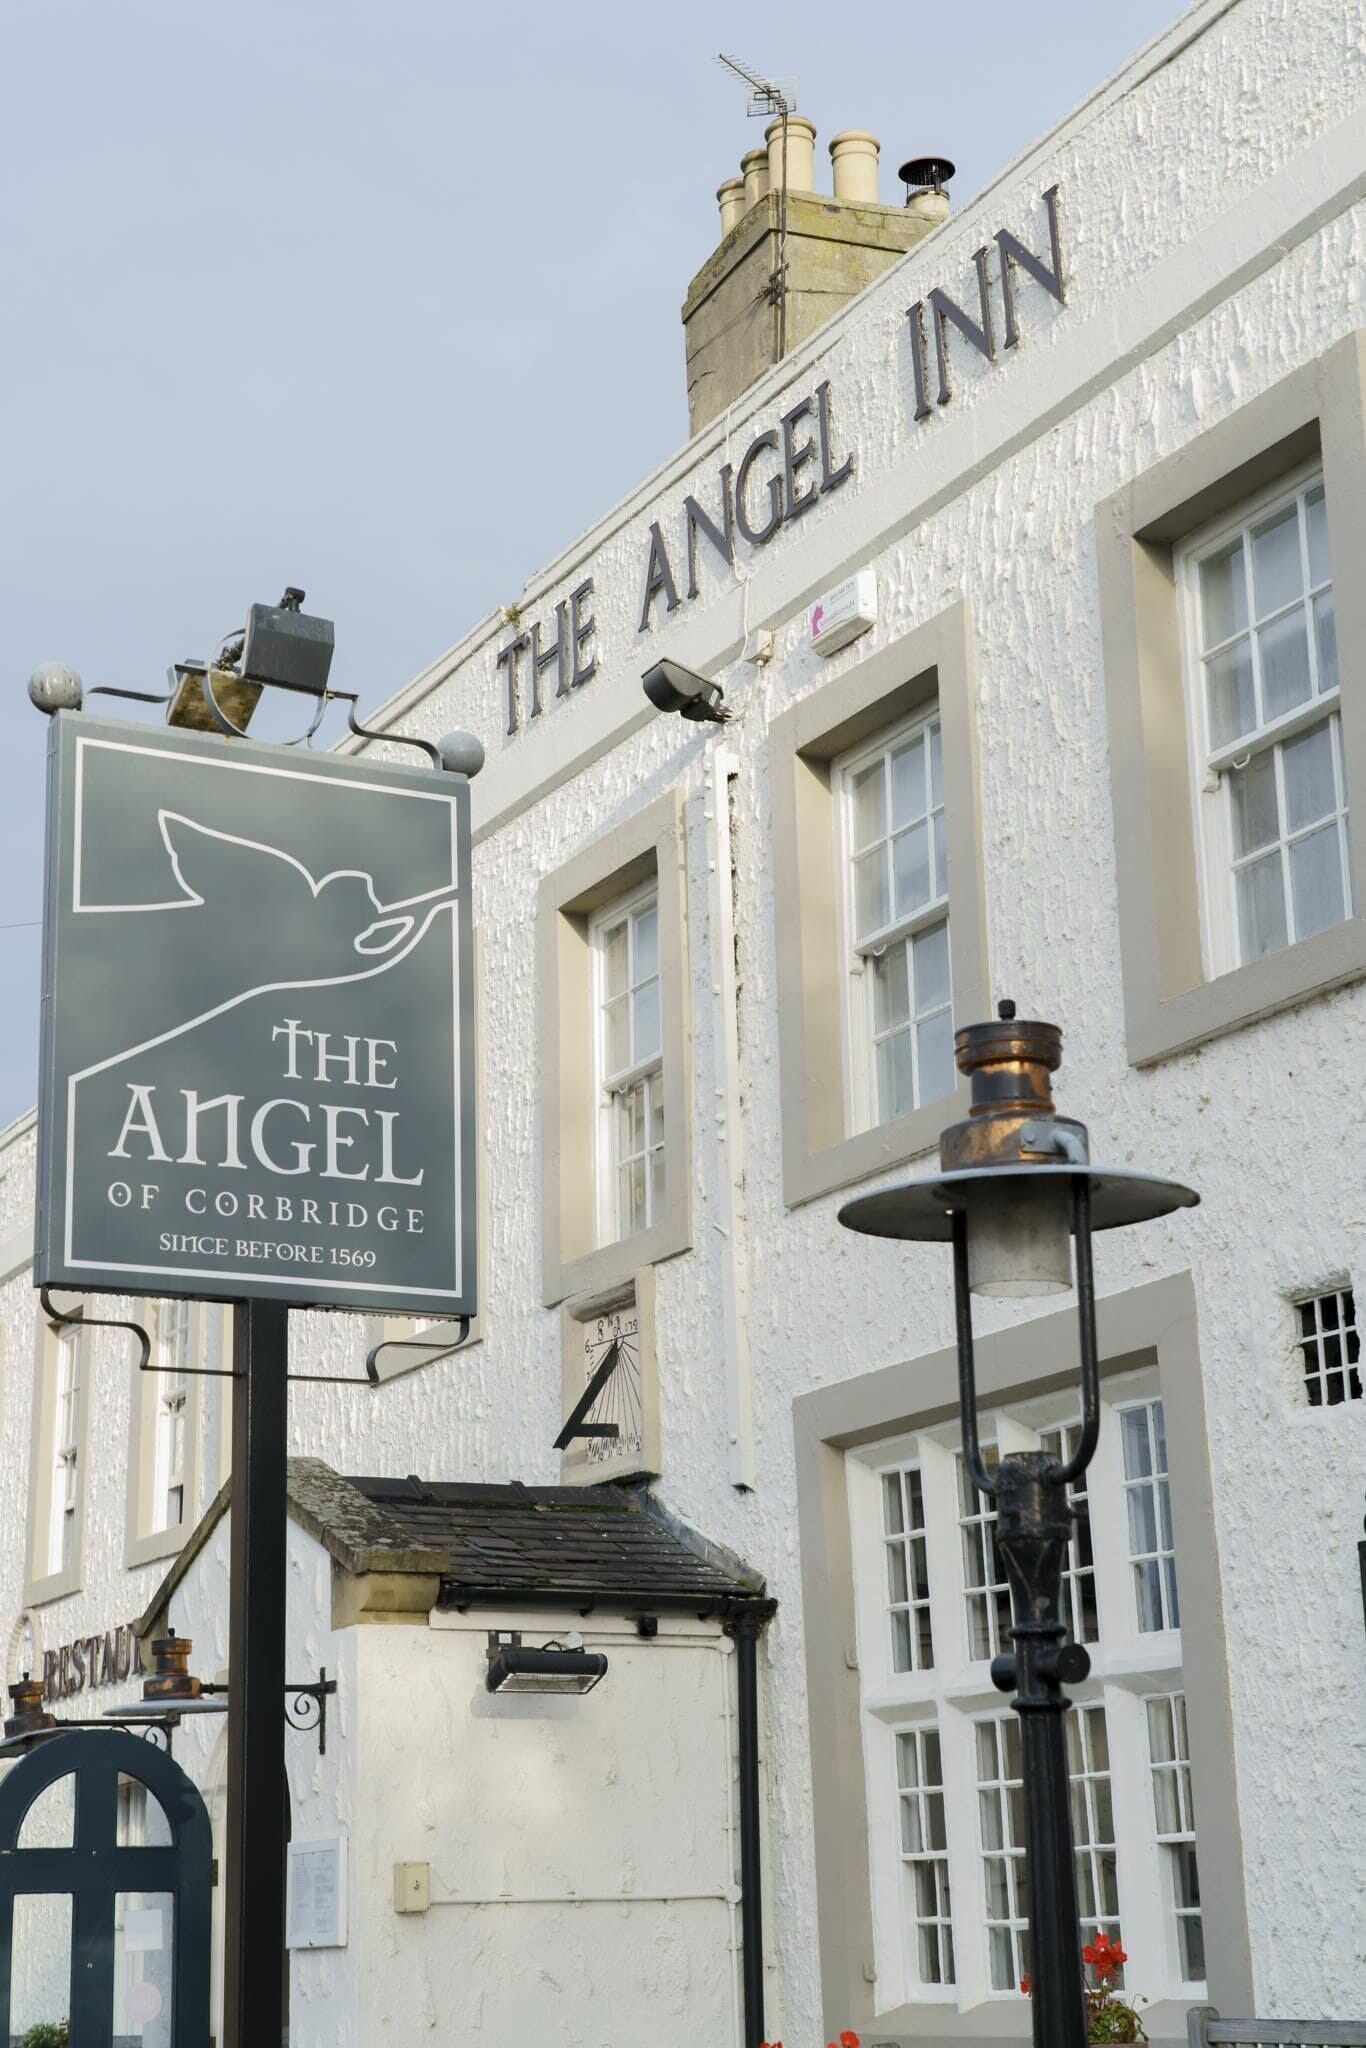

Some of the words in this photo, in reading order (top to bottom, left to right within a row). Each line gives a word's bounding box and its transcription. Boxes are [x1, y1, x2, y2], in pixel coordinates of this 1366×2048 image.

[497, 577, 599, 735] THE
[638, 379, 854, 633] ANGEL
[906, 183, 1066, 421] INN
[272, 1018, 398, 1089] THE
[107, 1083, 424, 1186] ANGEL
[107, 1181, 160, 1210] OF
[185, 1188, 424, 1233] CORBRIDGE
[159, 1232, 229, 1256] SINCE
[235, 1239, 324, 1264] BEFORE
[330, 1247, 377, 1269] 1569
